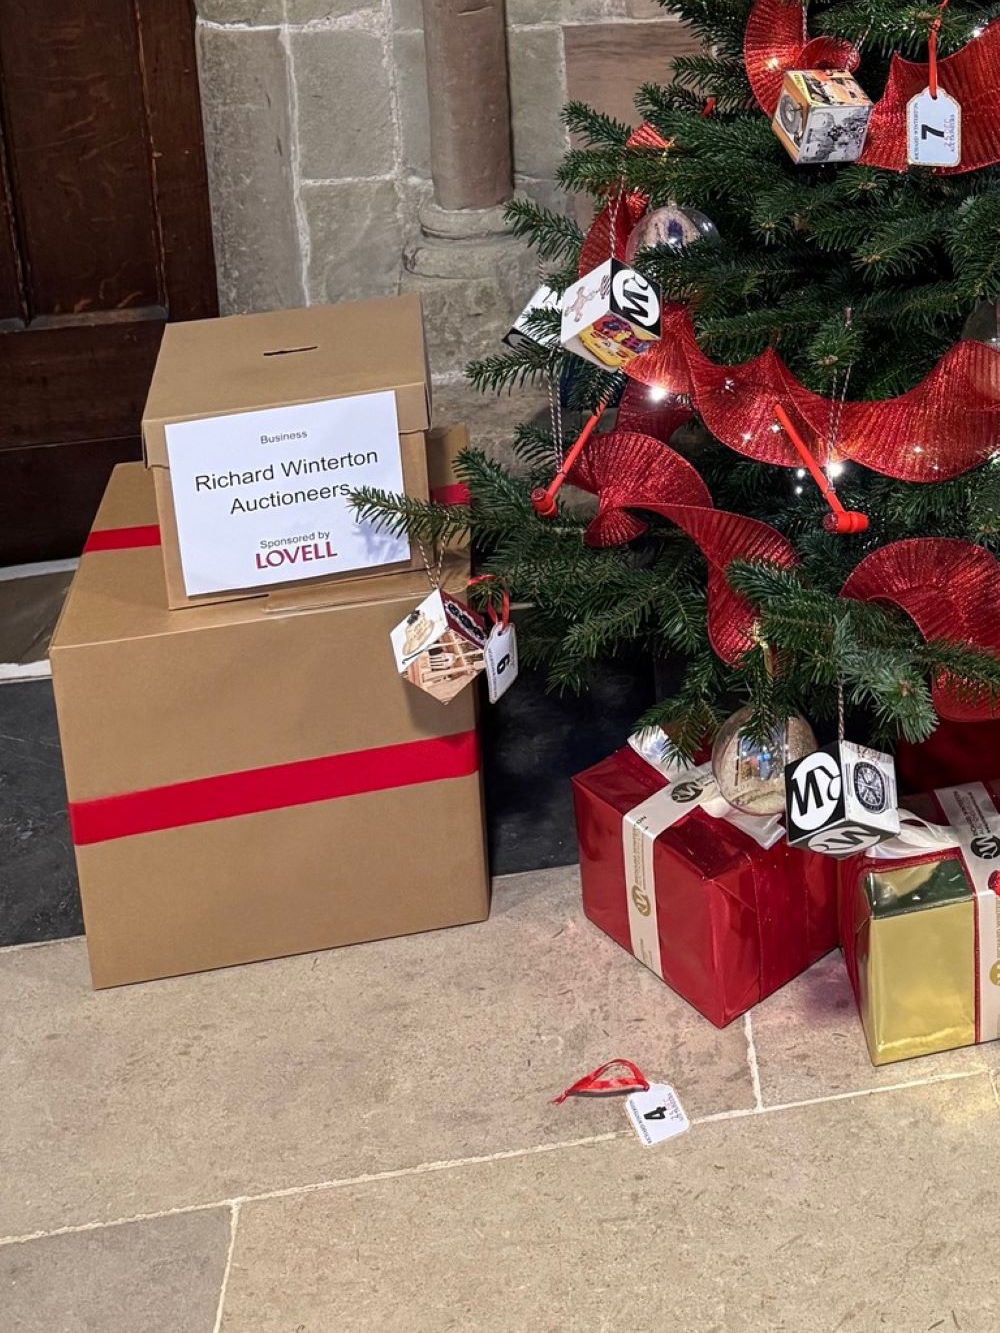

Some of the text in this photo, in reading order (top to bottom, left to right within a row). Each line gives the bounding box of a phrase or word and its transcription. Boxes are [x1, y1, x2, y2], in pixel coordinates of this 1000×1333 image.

[921, 123, 944, 141] 7
[259, 429, 308, 445] Business
[194, 450, 379, 492] Richard Winterton
[229, 482, 352, 515] Auctioneers
[259, 529, 331, 550] Sponsored by
[255, 540, 338, 570] LOVELL
[496, 653, 511, 675] 9
[643, 1106, 667, 1120] 4
